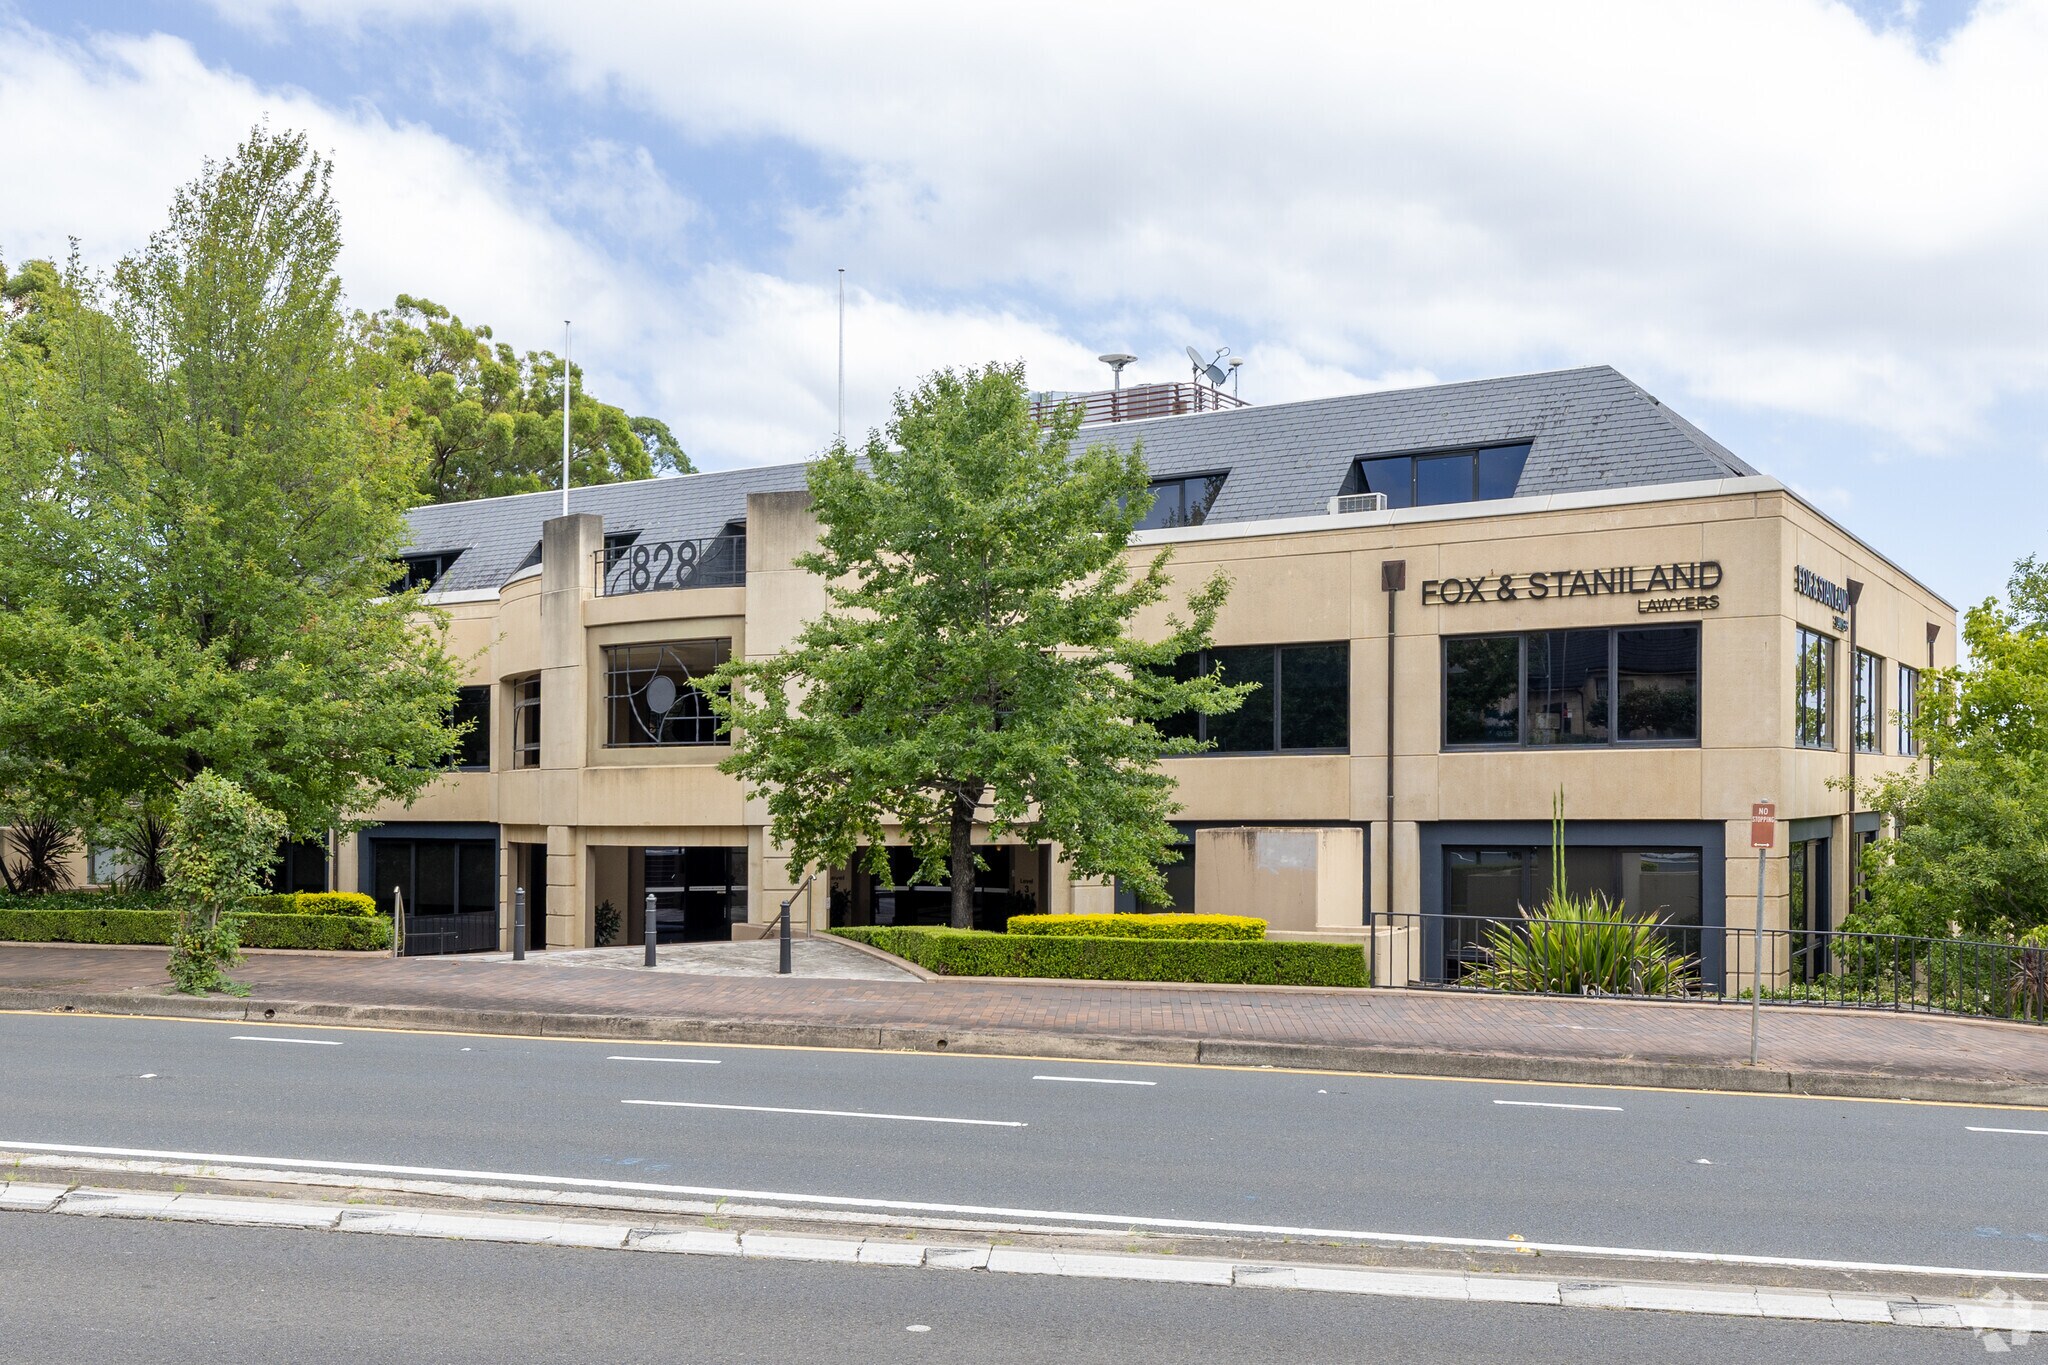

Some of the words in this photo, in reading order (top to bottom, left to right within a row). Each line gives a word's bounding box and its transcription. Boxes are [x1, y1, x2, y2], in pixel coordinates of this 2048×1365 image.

[632, 540, 697, 591] 828
[1422, 576, 1486, 606] FOX
[1497, 574, 1518, 601] &
[1528, 561, 1723, 600] STANILAND
[1637, 594, 1720, 614] LAWYERS
[1758, 807, 1769, 815] NO
[1024, 885, 1029, 893] 3
